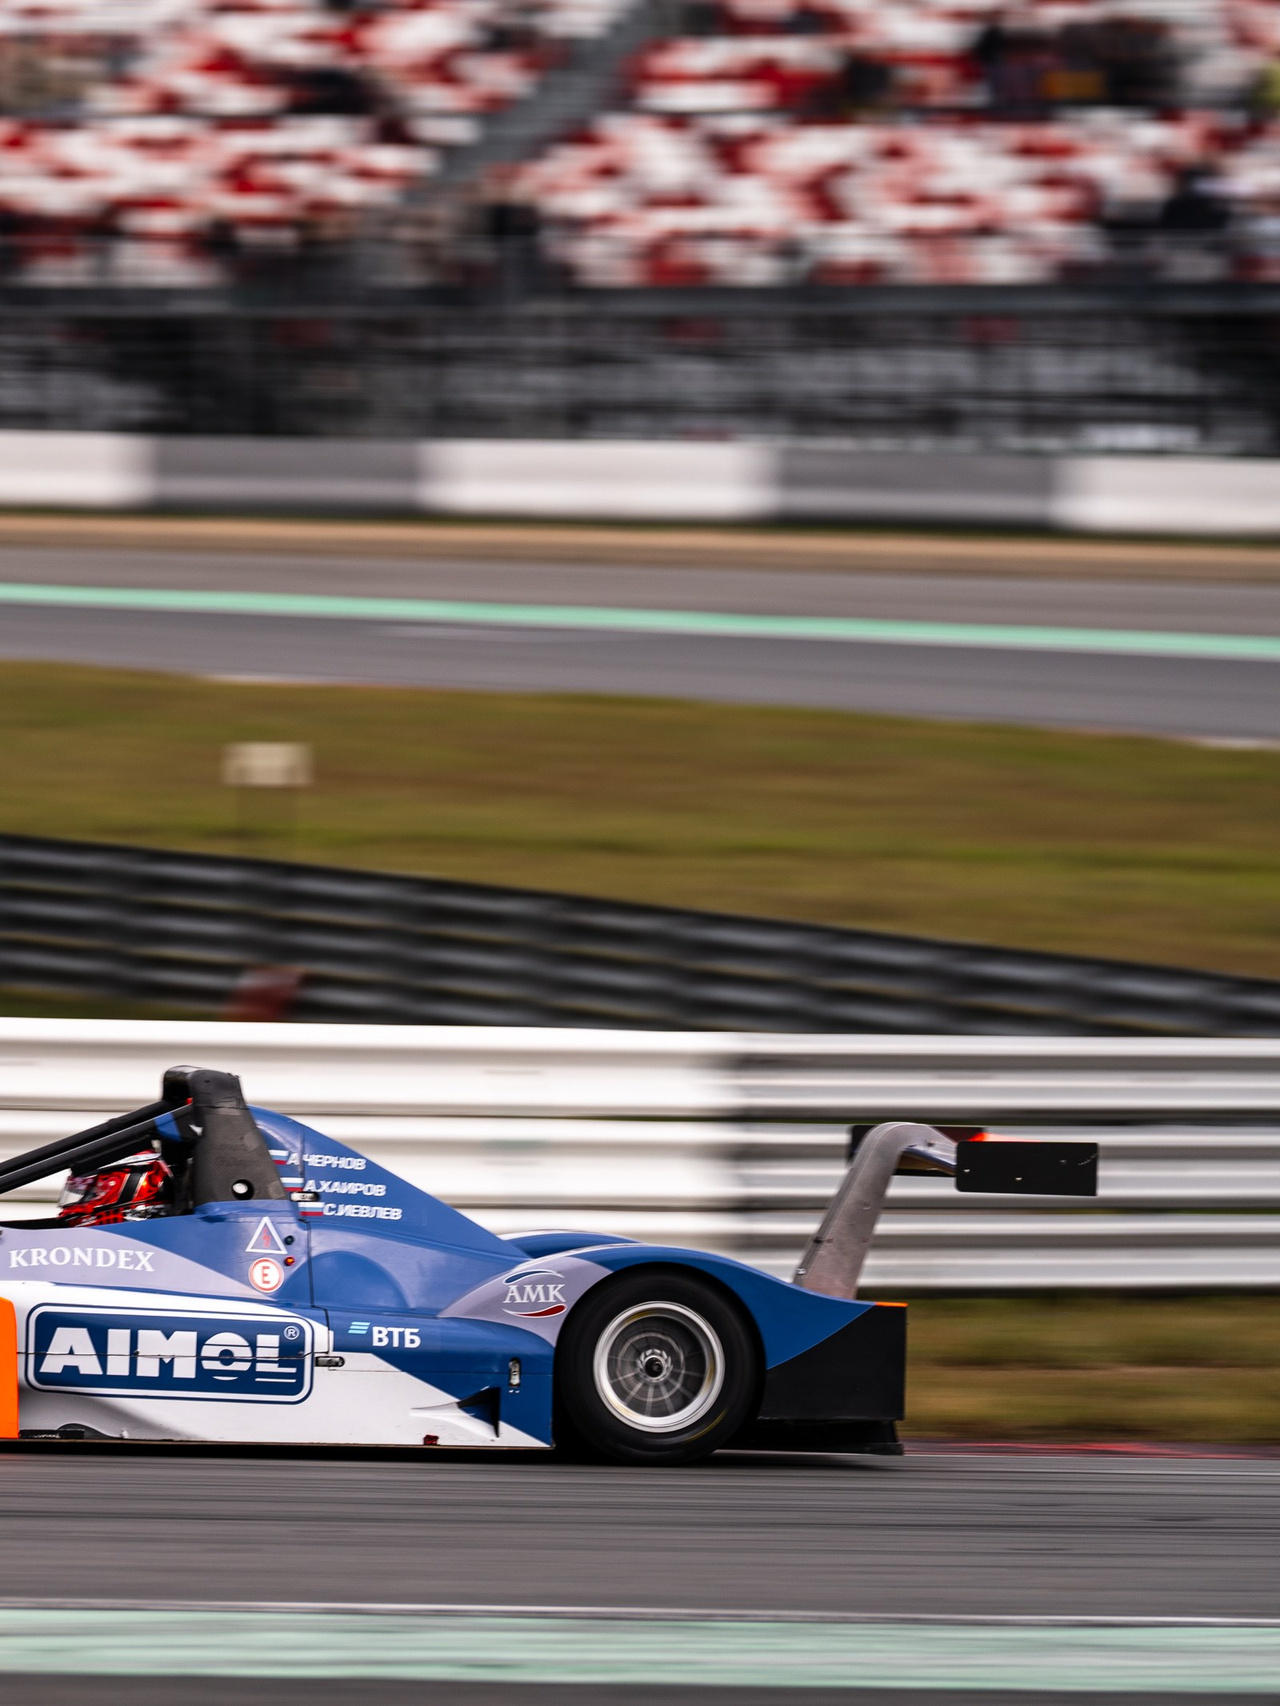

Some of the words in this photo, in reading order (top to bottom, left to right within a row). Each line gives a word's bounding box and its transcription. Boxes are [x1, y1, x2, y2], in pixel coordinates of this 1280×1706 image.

[302, 1153, 366, 1170] ЧЕРНОВ
[9, 1247, 156, 1272] KRONDEX
[262, 1266, 271, 1284] E
[502, 1284, 567, 1303] AMK
[372, 1326, 421, 1348] ВТБ
